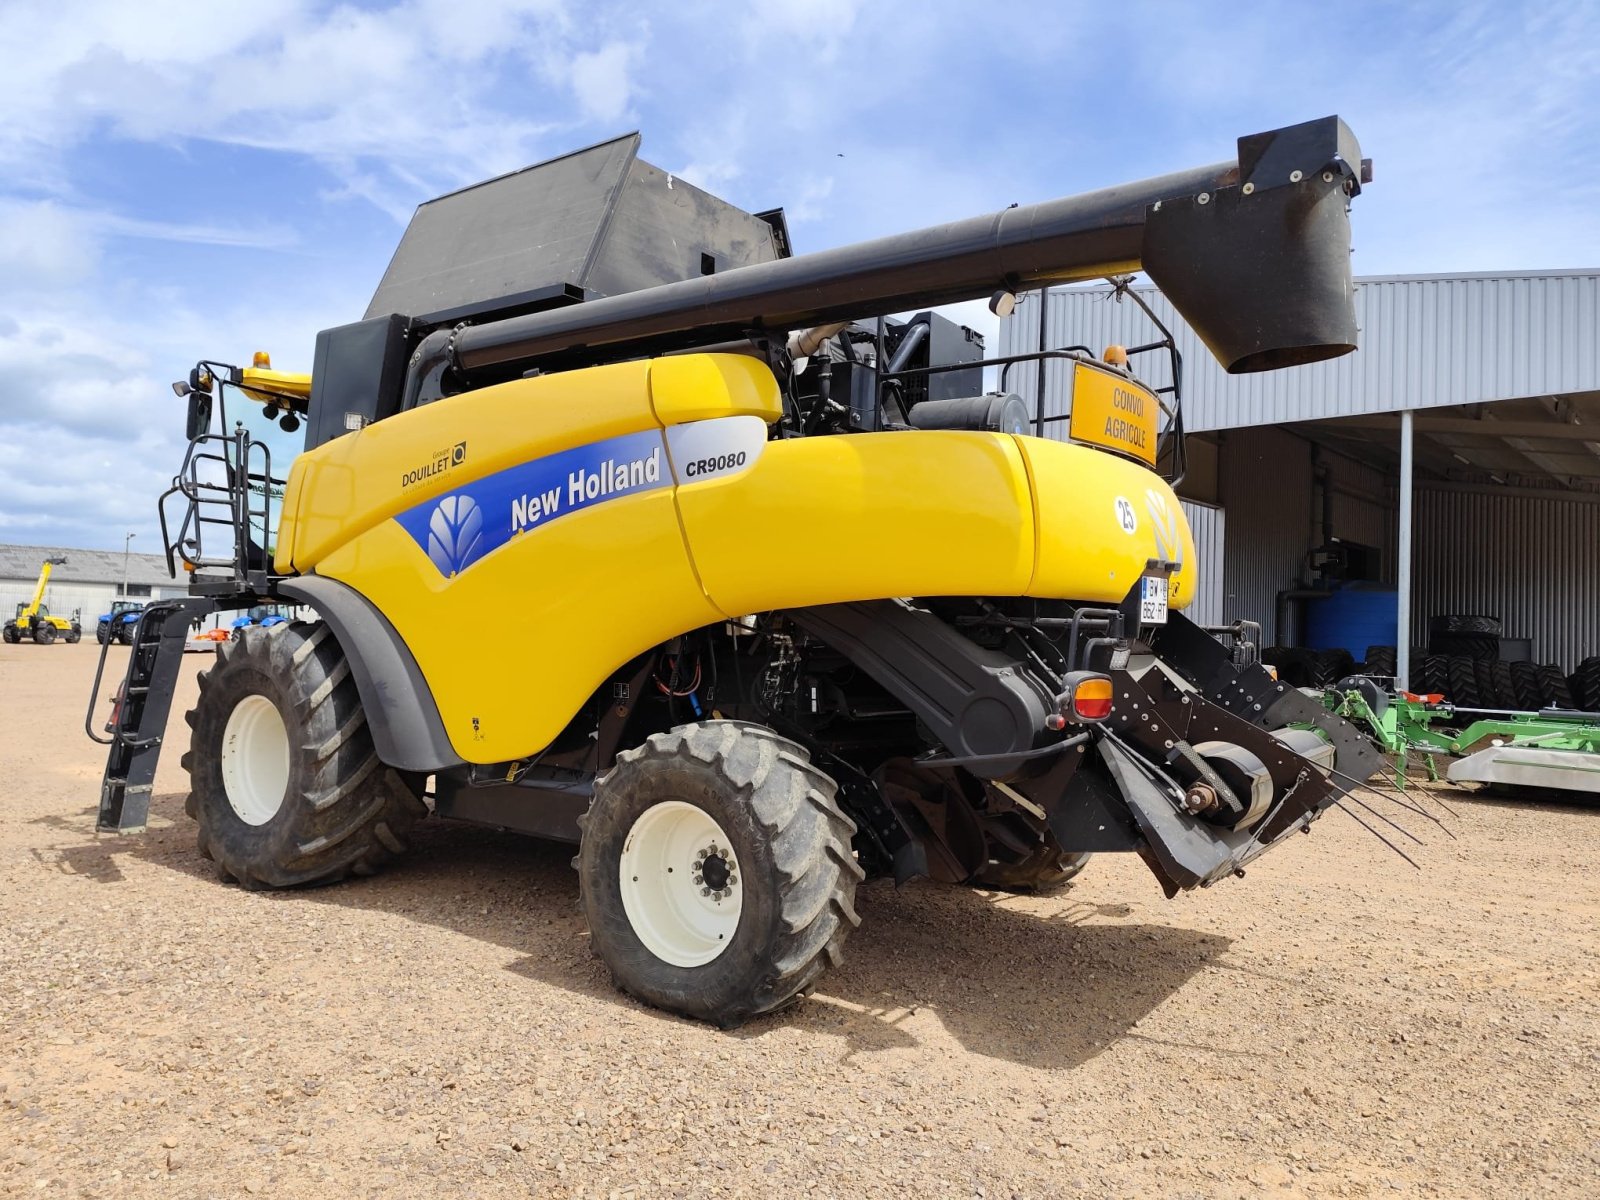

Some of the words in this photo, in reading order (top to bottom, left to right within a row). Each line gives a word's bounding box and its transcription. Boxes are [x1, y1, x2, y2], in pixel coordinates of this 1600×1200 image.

[1113, 387, 1144, 417] CONVOI
[1104, 416, 1146, 449] AGRICOLE
[402, 457, 449, 487] DOUILLET
[685, 451, 746, 477] CR9080
[511, 486, 561, 532] New
[568, 447, 660, 506] Holland
[1117, 499, 1135, 530] 25
